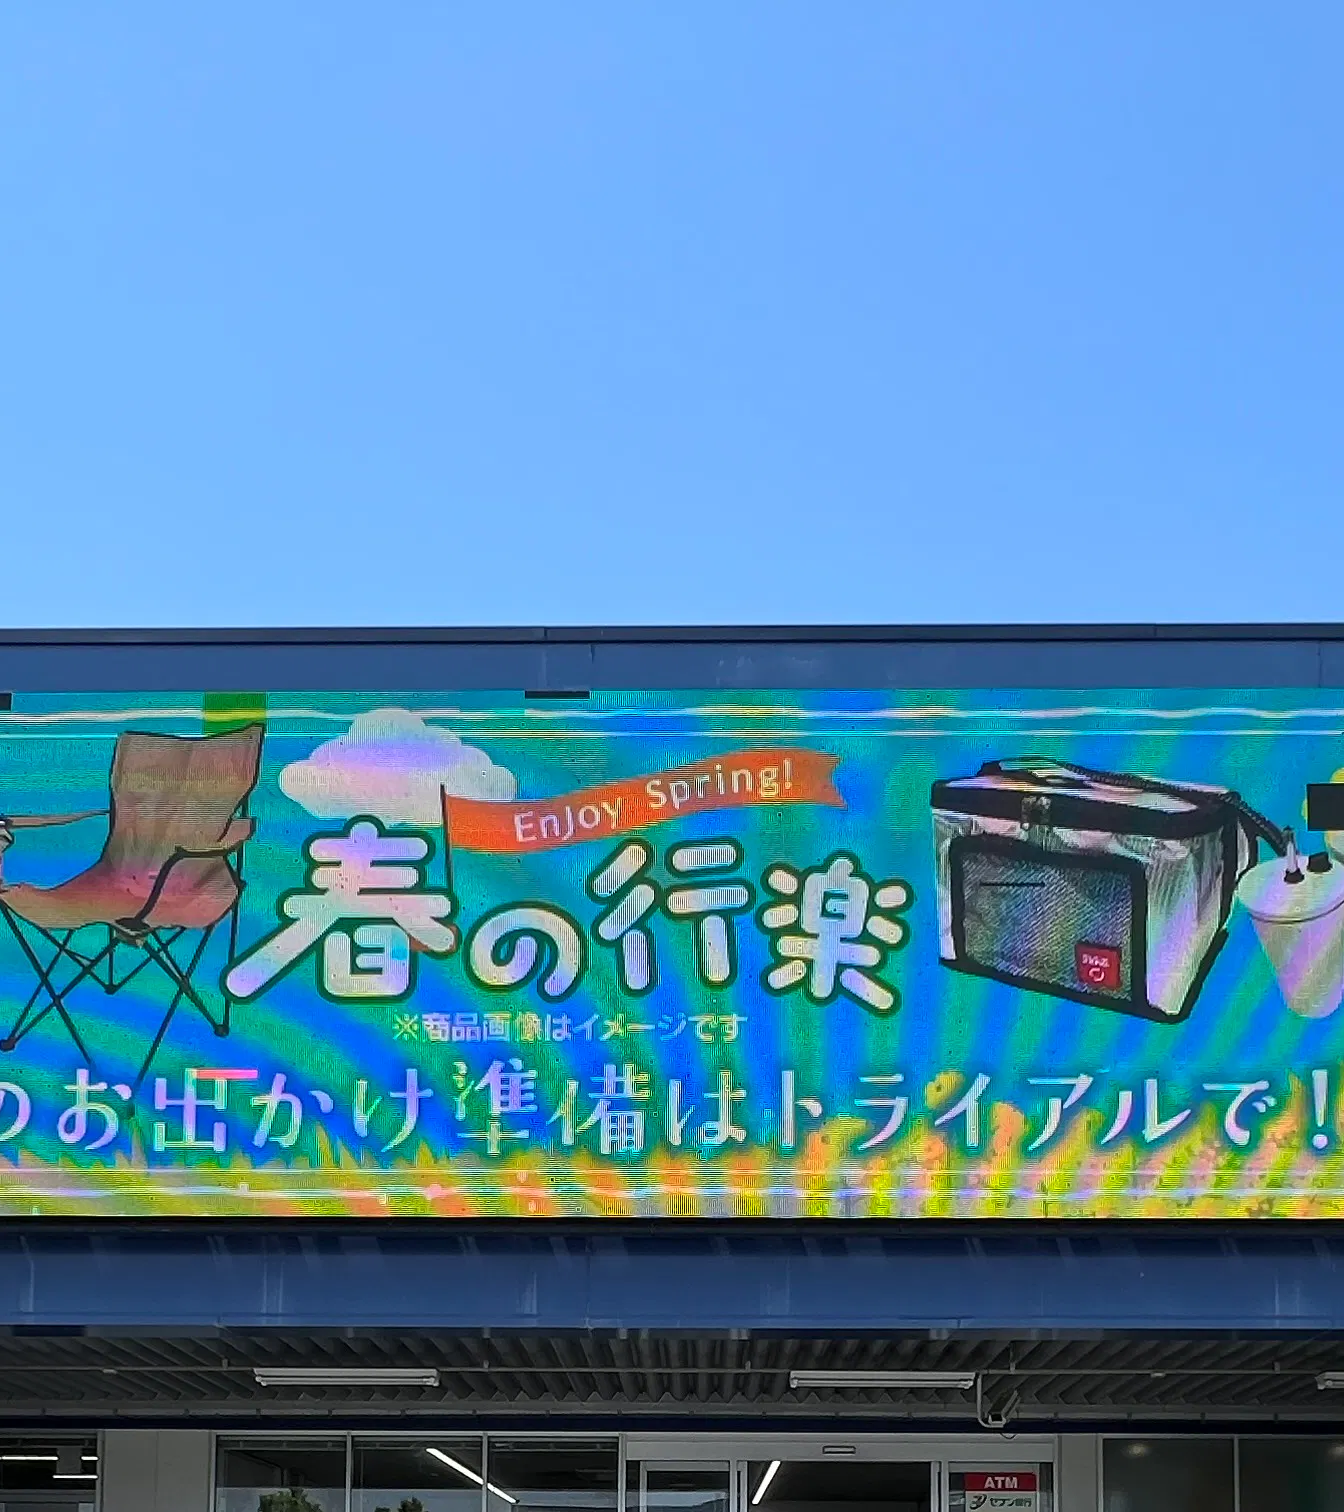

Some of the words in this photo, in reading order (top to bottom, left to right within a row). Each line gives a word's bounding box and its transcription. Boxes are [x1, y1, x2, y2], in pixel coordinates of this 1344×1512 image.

[645, 758, 796, 812] Spring!
[223, 816, 912, 1013] 春の行楽
[391, 1011, 748, 1044] ※商品画像はイメージです
[984, 1476, 1018, 1489] ATM
